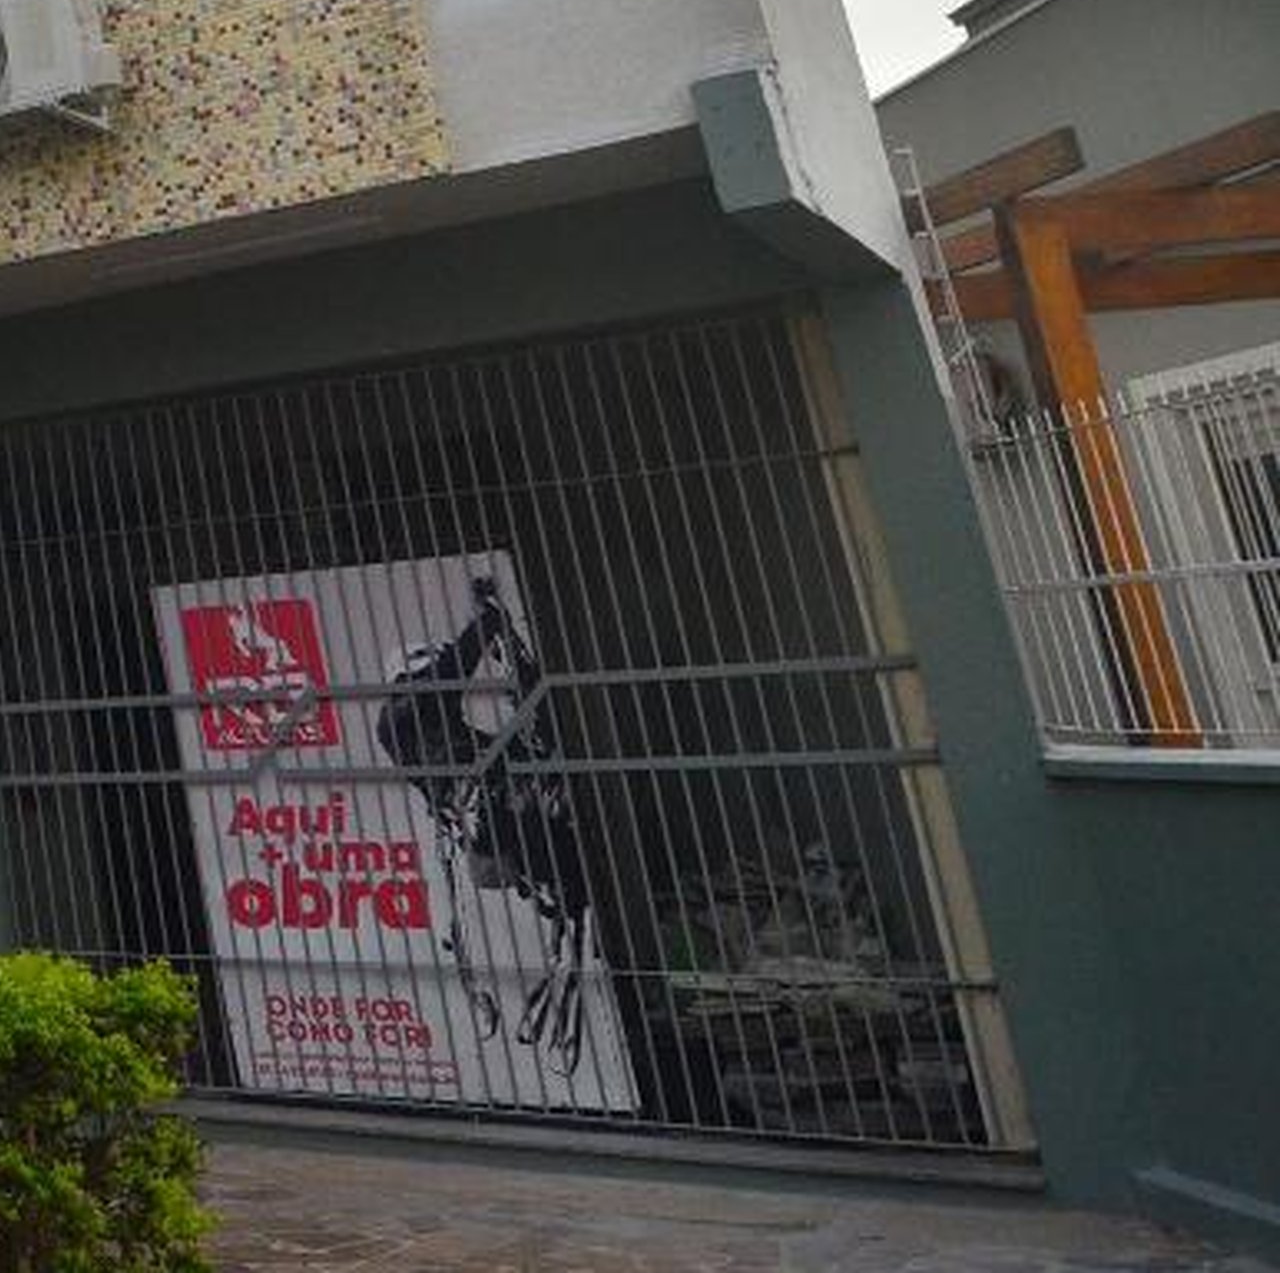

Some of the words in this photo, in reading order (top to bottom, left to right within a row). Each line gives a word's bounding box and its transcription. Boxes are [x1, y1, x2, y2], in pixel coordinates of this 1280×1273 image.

[227, 791, 345, 845] Aqui
[303, 841, 419, 872] uma
[227, 862, 431, 929] obra
[266, 995, 344, 1019] ONDE
